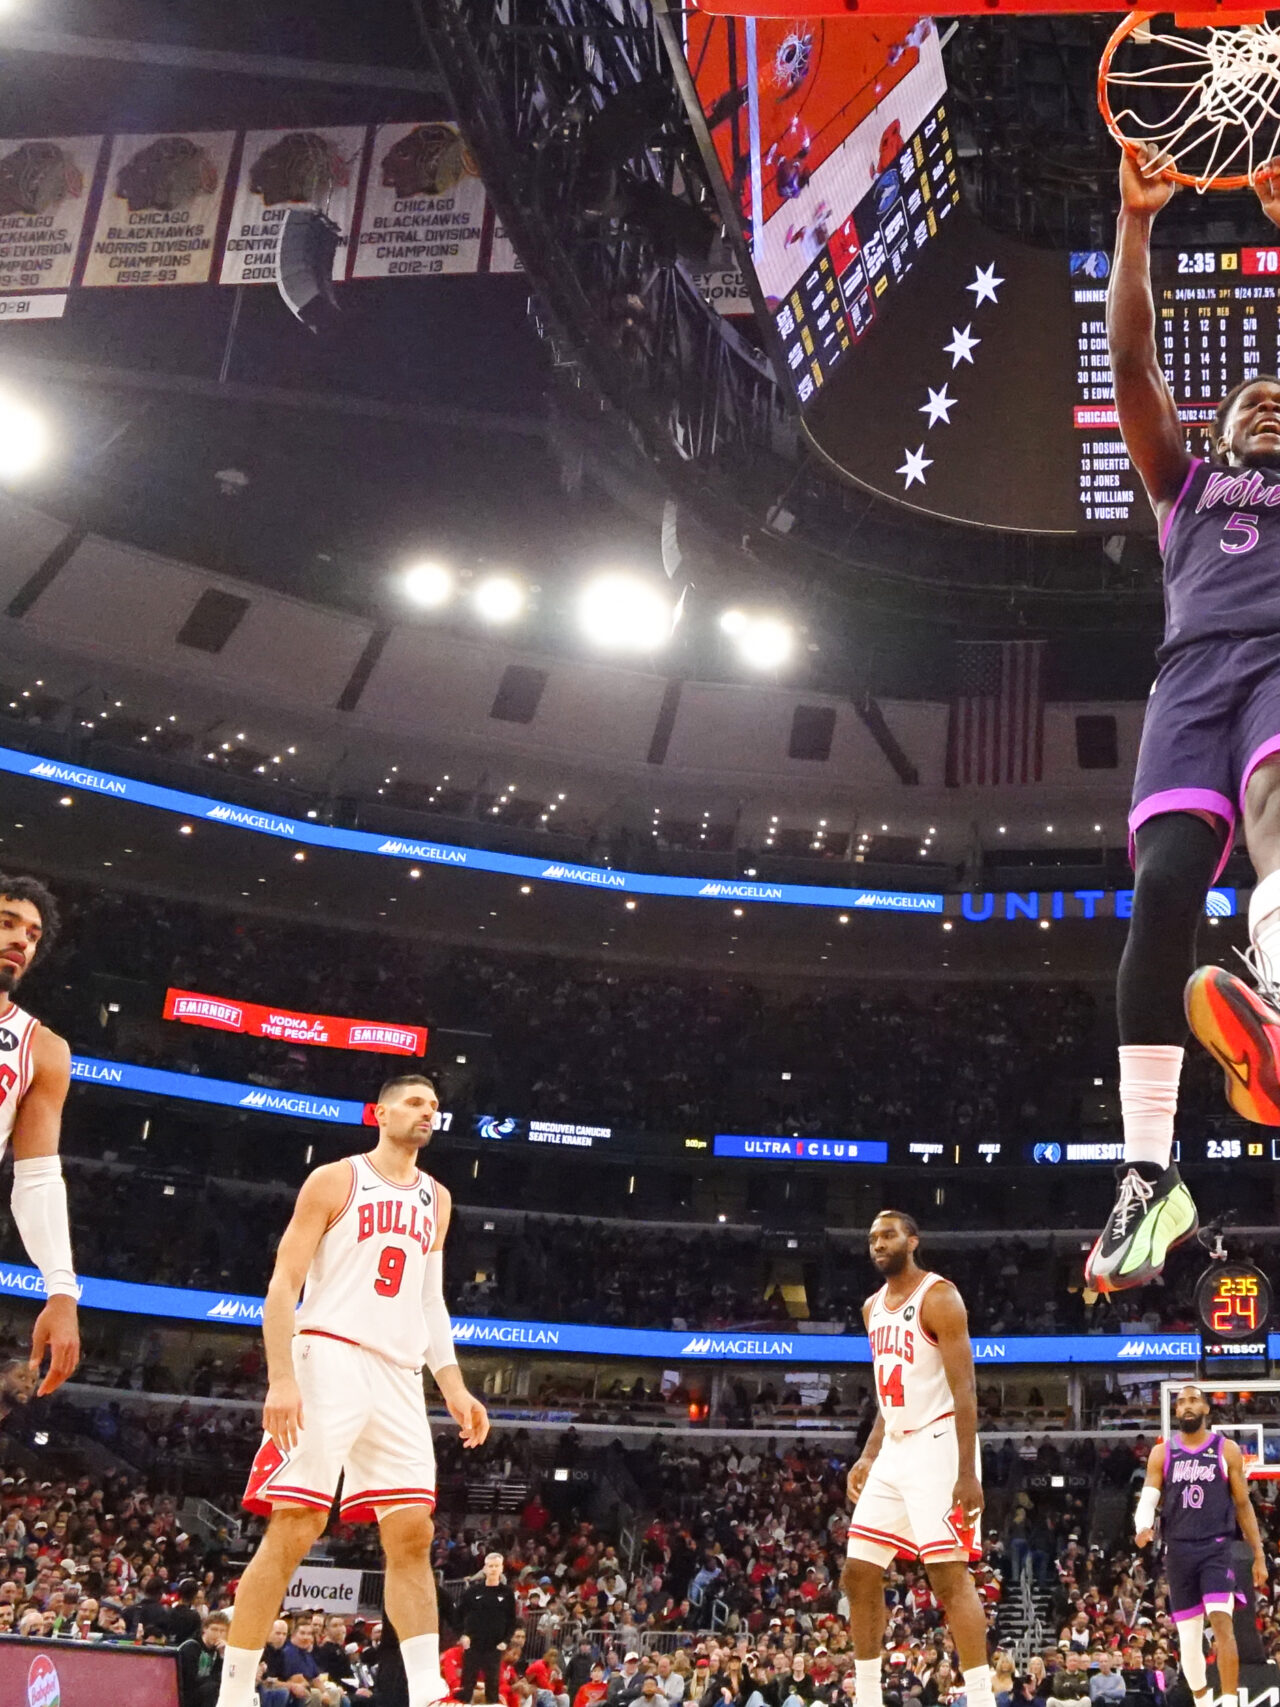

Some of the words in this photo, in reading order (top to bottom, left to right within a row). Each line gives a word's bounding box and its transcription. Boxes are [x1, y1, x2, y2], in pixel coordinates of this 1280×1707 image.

[394, 198, 455, 213] CHICAGO
[129, 212, 190, 225] CHICAGO
[374, 213, 470, 229] BLACKHAWKS
[107, 225, 204, 239] BLACKHAWKS
[359, 231, 421, 245] CENTRAL
[425, 228, 480, 242] DIVISION
[94, 241, 148, 255] NORRIS
[151, 238, 211, 252] DIVISION
[376, 244, 459, 259] CHAMPIONS
[109, 254, 191, 268] CHAMPIONS
[863, 231, 885, 279] 2:35
[1178, 252, 1216, 273] 2:35
[1227, 256, 1233, 269] 3
[1256, 251, 1279, 272] 70
[388, 261, 443, 274] 2012-13
[117, 270, 177, 283] 1992-93
[1074, 289, 1108, 302] MINNES
[1081, 322, 1088, 334] 8
[1164, 320, 1173, 332] 11
[1183, 320, 1190, 332] 2
[1200, 319, 1210, 332] 12
[1220, 319, 1227, 331] 0
[1078, 338, 1088, 351] 10
[1164, 337, 1174, 349] 10
[1184, 336, 1189, 348] 1
[1202, 336, 1208, 348] 0
[1220, 335, 1227, 348] 0
[1080, 355, 1088, 367] 11
[1164, 353, 1174, 365] 17
[1184, 353, 1190, 365] 0
[1200, 352, 1210, 365] 14
[1220, 352, 1227, 364] 4
[1078, 371, 1088, 383] 30
[1164, 370, 1174, 381] 21
[1184, 369, 1190, 381] 2
[1202, 369, 1210, 381] 11
[1220, 369, 1227, 380] 3
[1083, 387, 1089, 400] 5
[1184, 385, 1191, 397] 0
[1220, 385, 1227, 397] 2
[1082, 443, 1090, 454] 11
[1185, 440, 1191, 452] 2
[1204, 440, 1210, 452] 4
[1081, 459, 1090, 470] 13
[1093, 458, 1130, 470] HUERTER
[1080, 475, 1091, 487] 30
[1093, 475, 1120, 487] JONES
[1080, 492, 1091, 503] 44
[1094, 490, 1134, 503] WILLIAMS
[1086, 508, 1091, 519] 9
[1094, 507, 1129, 519] VUCEVIC
[1220, 511, 1260, 555] 5
[54, 766, 126, 794] MAGELLAN
[230, 810, 295, 835] MAGELLAN
[401, 842, 467, 863] MAGELLAN
[564, 867, 625, 887] MAGELLAN
[721, 885, 782, 899] MAGELLAN
[875, 895, 936, 909] MAGELLAN
[961, 889, 1135, 922] UNITE
[179, 1000, 238, 1022] SMIRNOFF
[269, 1014, 307, 1029] VODKA
[261, 1023, 282, 1036] THE
[284, 1029, 328, 1042] PEOPLE
[354, 1029, 413, 1046] SMIRNOFF
[266, 1096, 340, 1118] MAGELLAN
[530, 1121, 576, 1135] VANCOUVER
[576, 1124, 611, 1138] CANUCKS
[528, 1131, 560, 1144] SEATTLE
[562, 1134, 592, 1146] KRAKEN
[744, 1141, 791, 1154] ULTRA
[808, 1142, 858, 1157] CLUB
[1207, 1140, 1240, 1158] 2:35
[357, 1200, 432, 1255] BULLS
[374, 1246, 407, 1298] 9
[1219, 1279, 1258, 1296] 2:35
[1212, 1297, 1255, 1330] 24
[474, 1326, 559, 1344] MAGELLAN
[711, 1341, 793, 1355] MAGELLAN
[1146, 1342, 1201, 1356] MAGELL
[1222, 1344, 1266, 1354] TISSOT
[1172, 1459, 1216, 1483] Wolves
[1181, 1484, 1204, 1509] 10
[286, 1578, 354, 1600] dvocate
